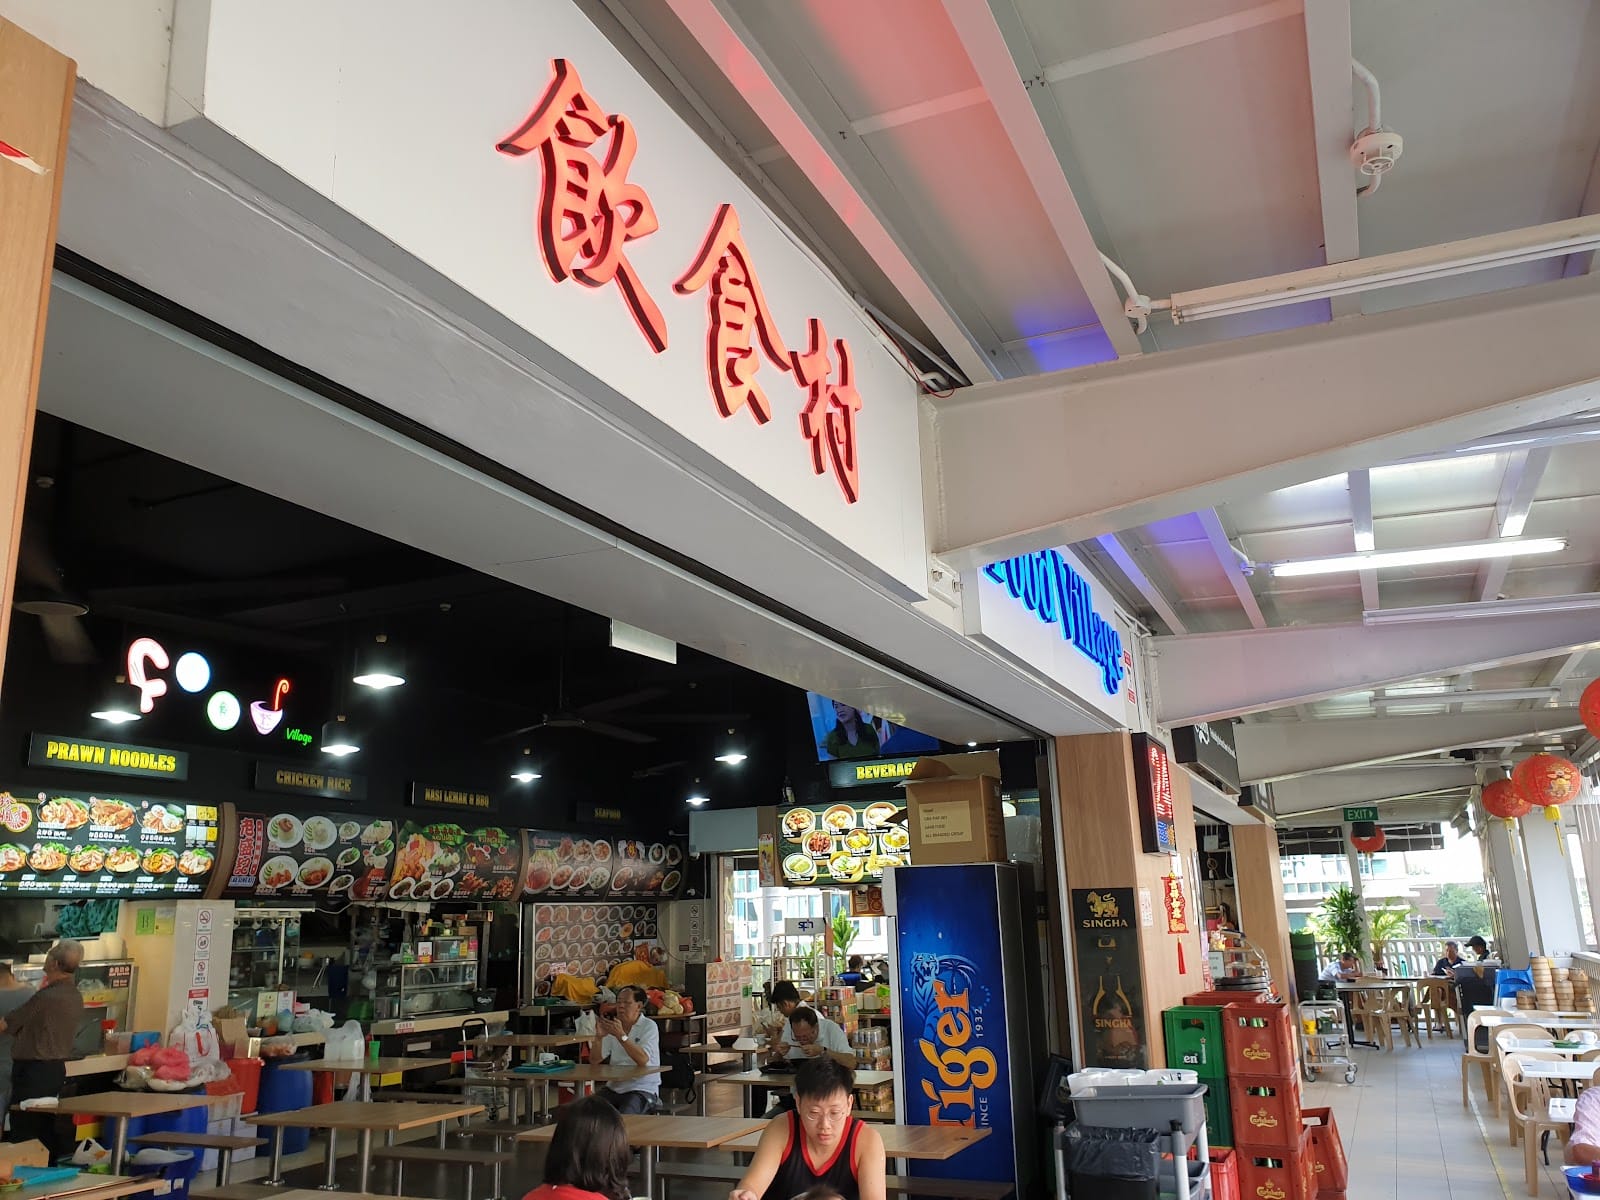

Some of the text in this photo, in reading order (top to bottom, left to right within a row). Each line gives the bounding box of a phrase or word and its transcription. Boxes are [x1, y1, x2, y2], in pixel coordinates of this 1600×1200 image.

[286, 728, 313, 745] Village
[46, 741, 176, 772] PRAWN NOODLES
[276, 769, 352, 792] CHICKEN RICE
[425, 787, 443, 802] NASI
[444, 789, 468, 806] LEMAK
[476, 794, 490, 808] BBQ
[1347, 809, 1367, 819] EXIT
[798, 919, 814, 932] sph
[1082, 918, 1129, 929] SINGHA
[1095, 1017, 1134, 1029] SINGHA
[918, 979, 998, 1129] Tiger
[1243, 1048, 1271, 1060] Carlsberg
[975, 1007, 988, 1126] INCE 1932
[1249, 1115, 1278, 1128] Carlsberg
[1256, 1185, 1286, 1200] Carlsberg
